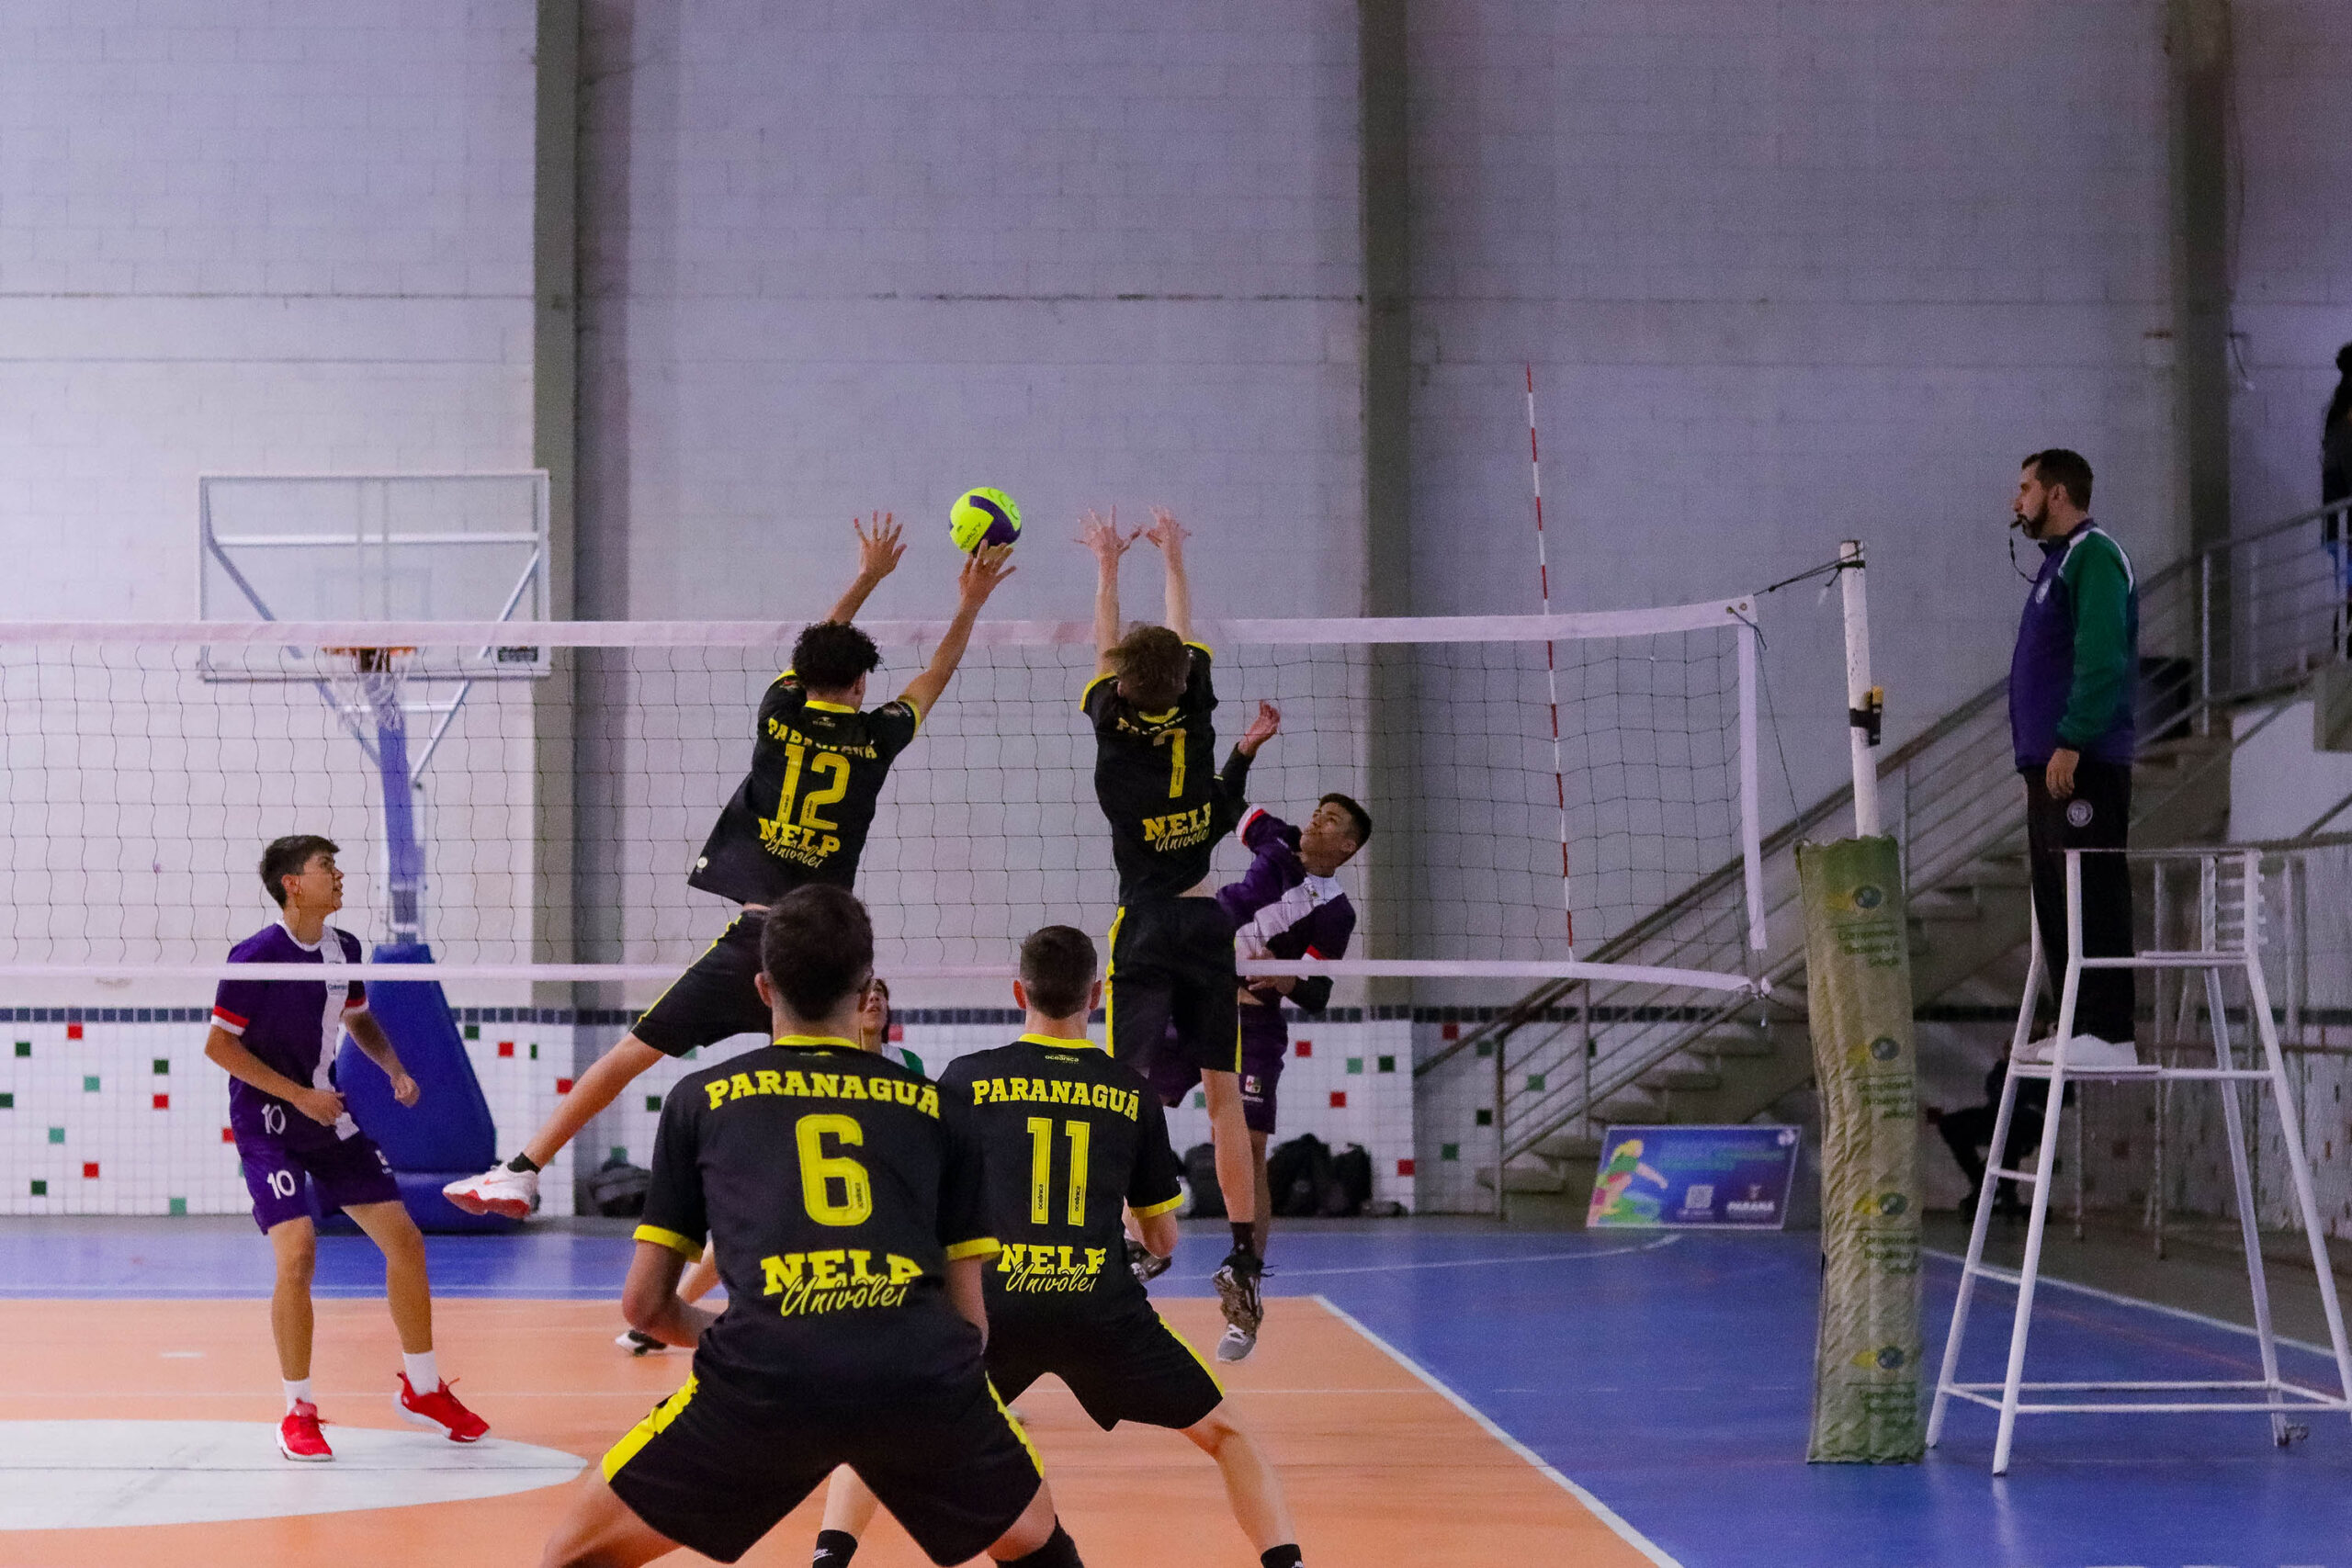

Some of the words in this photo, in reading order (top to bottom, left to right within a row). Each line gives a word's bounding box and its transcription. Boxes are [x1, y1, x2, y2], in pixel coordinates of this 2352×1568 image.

[1153, 728, 1187, 798] 7
[775, 743, 851, 830] 12
[758, 817, 841, 857] NELP
[705, 1070, 940, 1119] PARANAGUÁ
[972, 1077, 1139, 1122] PARANAGUÁ
[261, 1103, 286, 1134] 10
[267, 1169, 296, 1200] 10
[796, 1113, 873, 1226] 6
[1027, 1117, 1091, 1226] 11
[760, 1249, 923, 1296] NELP
[781, 1274, 910, 1316] Univôlei
[1005, 1262, 1101, 1293] Univôlei
